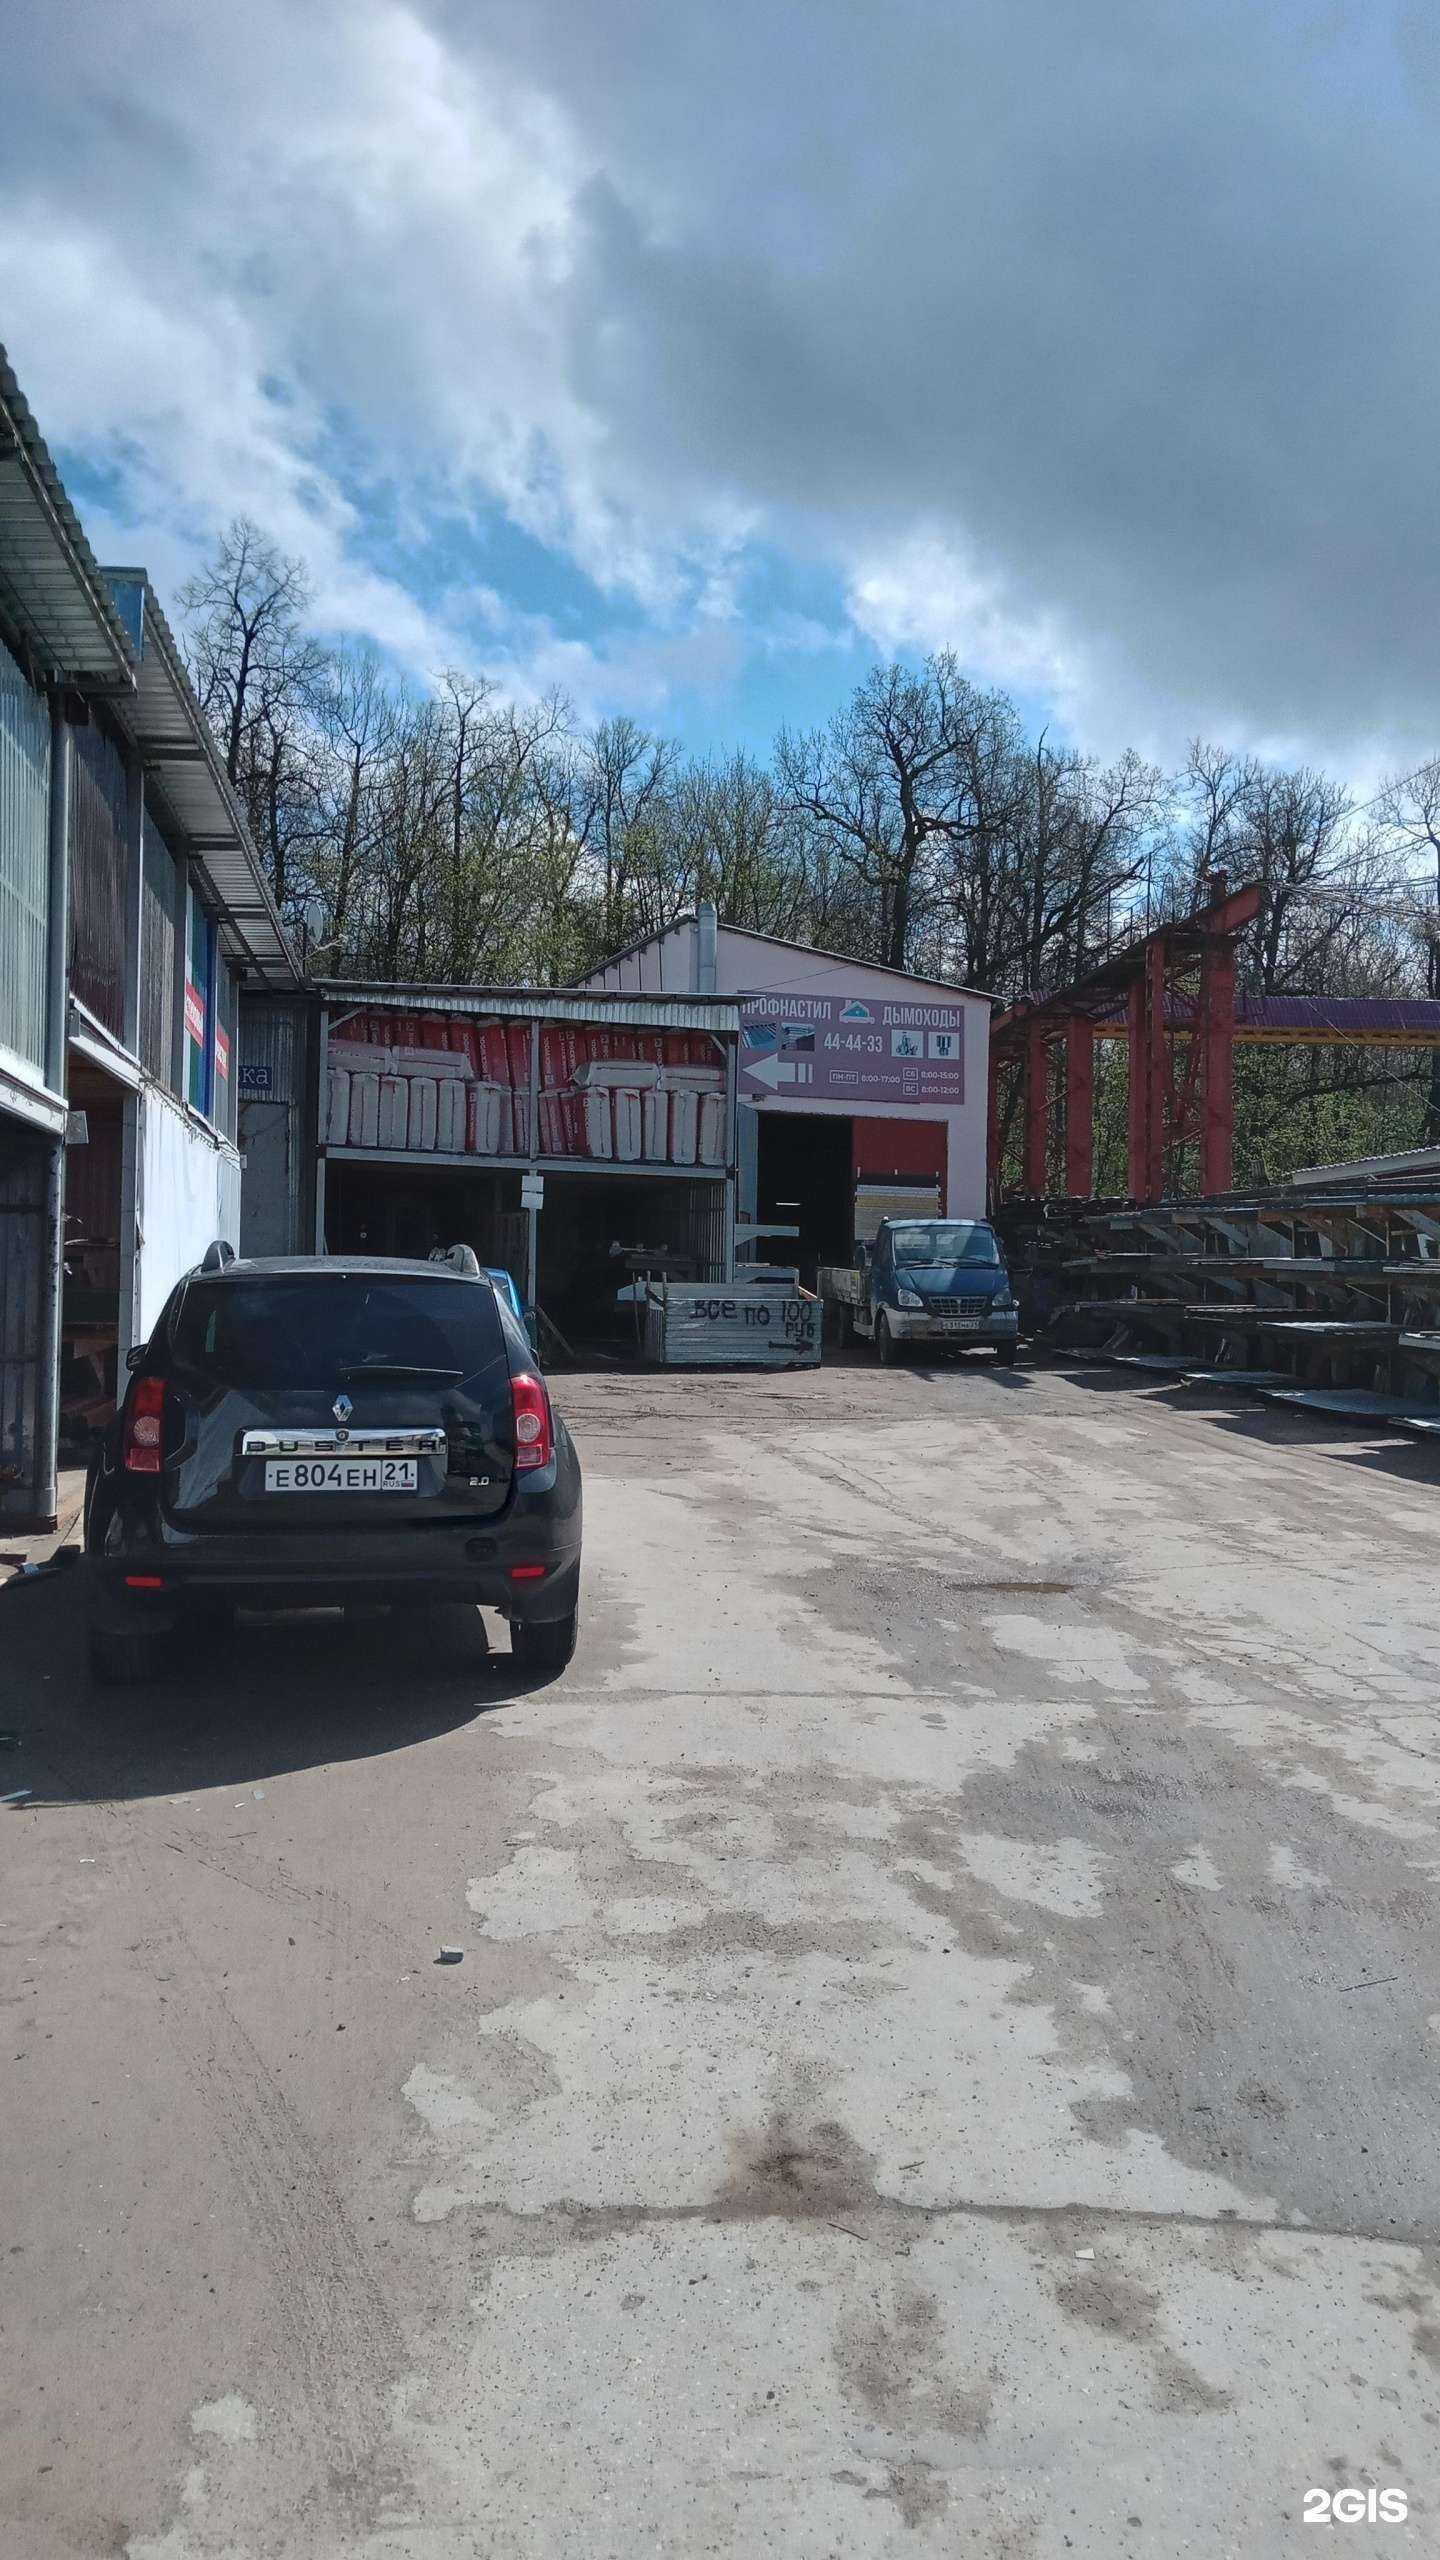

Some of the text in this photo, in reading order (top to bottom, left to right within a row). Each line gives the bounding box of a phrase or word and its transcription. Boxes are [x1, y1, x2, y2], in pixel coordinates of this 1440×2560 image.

[742, 998, 961, 1028] ПРОФНАСТИЛ ДЫМОХОДЫ
[824, 1032, 883, 1053] 44-44-33
[239, 1068, 269, 1085] ка
[781, 1300, 812, 1322] 100
[247, 1440, 438, 1452] DUSTER
[384, 1463, 409, 1480] 21
[382, 1480, 401, 1488] RUS
[470, 1476, 490, 1486] 2.0
